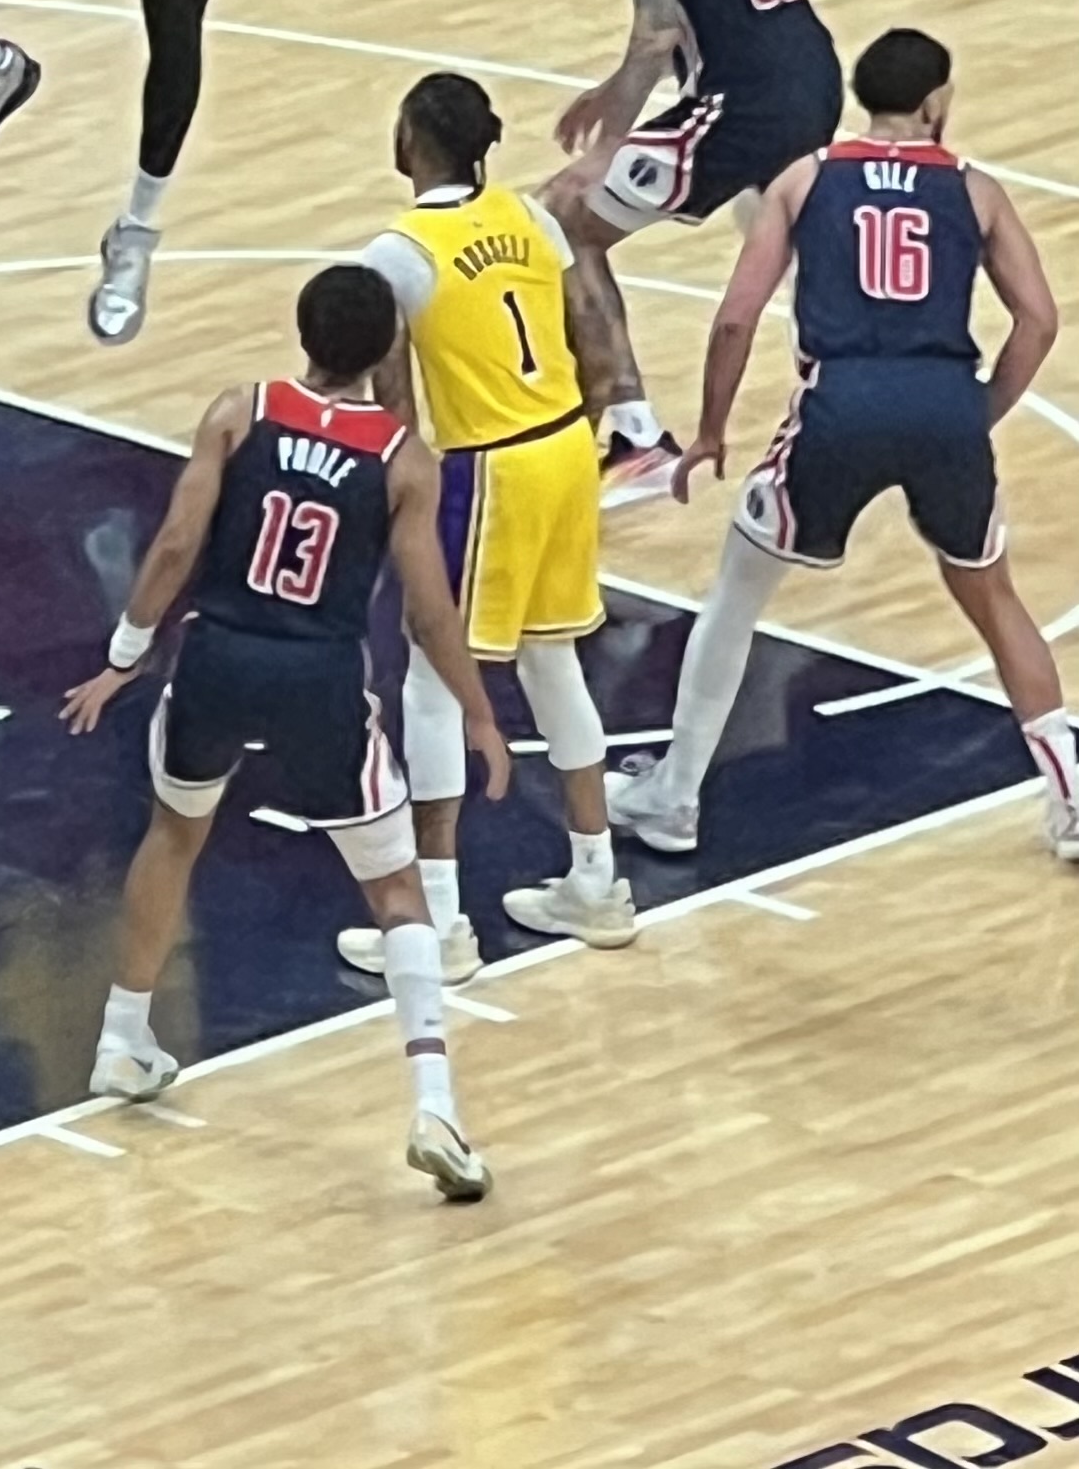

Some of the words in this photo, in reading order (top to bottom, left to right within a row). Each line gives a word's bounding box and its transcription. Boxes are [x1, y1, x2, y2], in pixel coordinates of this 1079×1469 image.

[863, 161, 918, 193] GILL
[454, 234, 530, 281] RUSSELL
[853, 205, 929, 302] 16
[502, 289, 538, 378] 1
[247, 490, 339, 605] 13
